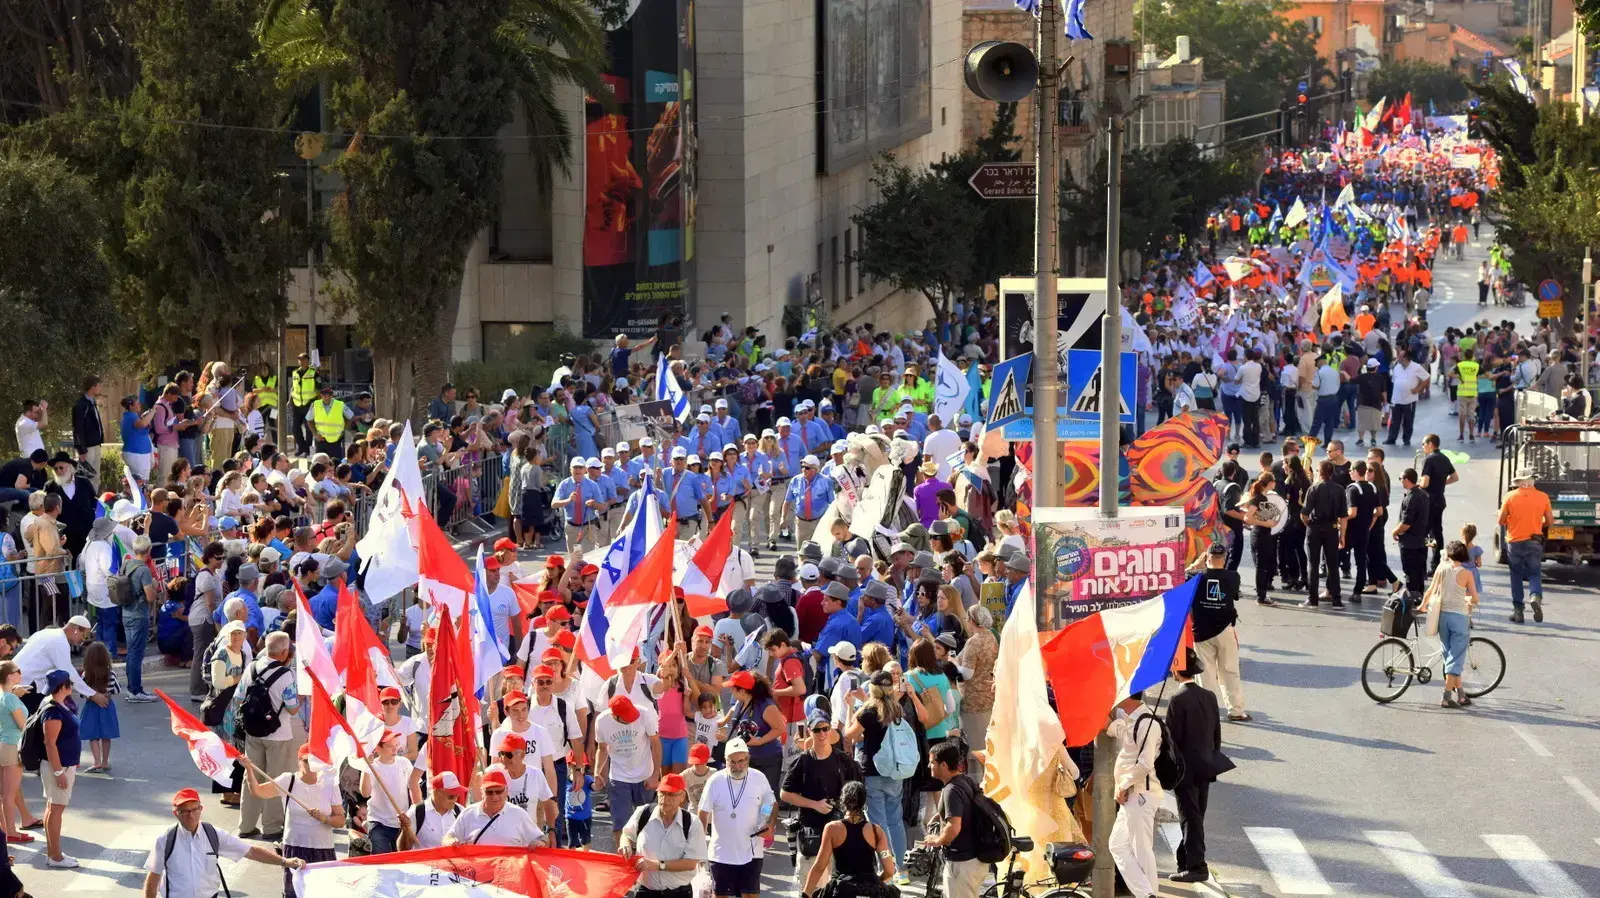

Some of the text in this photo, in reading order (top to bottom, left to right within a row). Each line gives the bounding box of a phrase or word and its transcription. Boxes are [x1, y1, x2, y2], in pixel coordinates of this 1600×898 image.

[1003, 168, 1023, 176] ז'ראר
[1057, 551, 1079, 561] ההרשמה
[1095, 547, 1175, 576] חוגים
[1080, 572, 1174, 596] בנחלאות
[698, 722, 710, 732] YAY!
[525, 740, 536, 754] GS
[507, 793, 529, 805] aris
